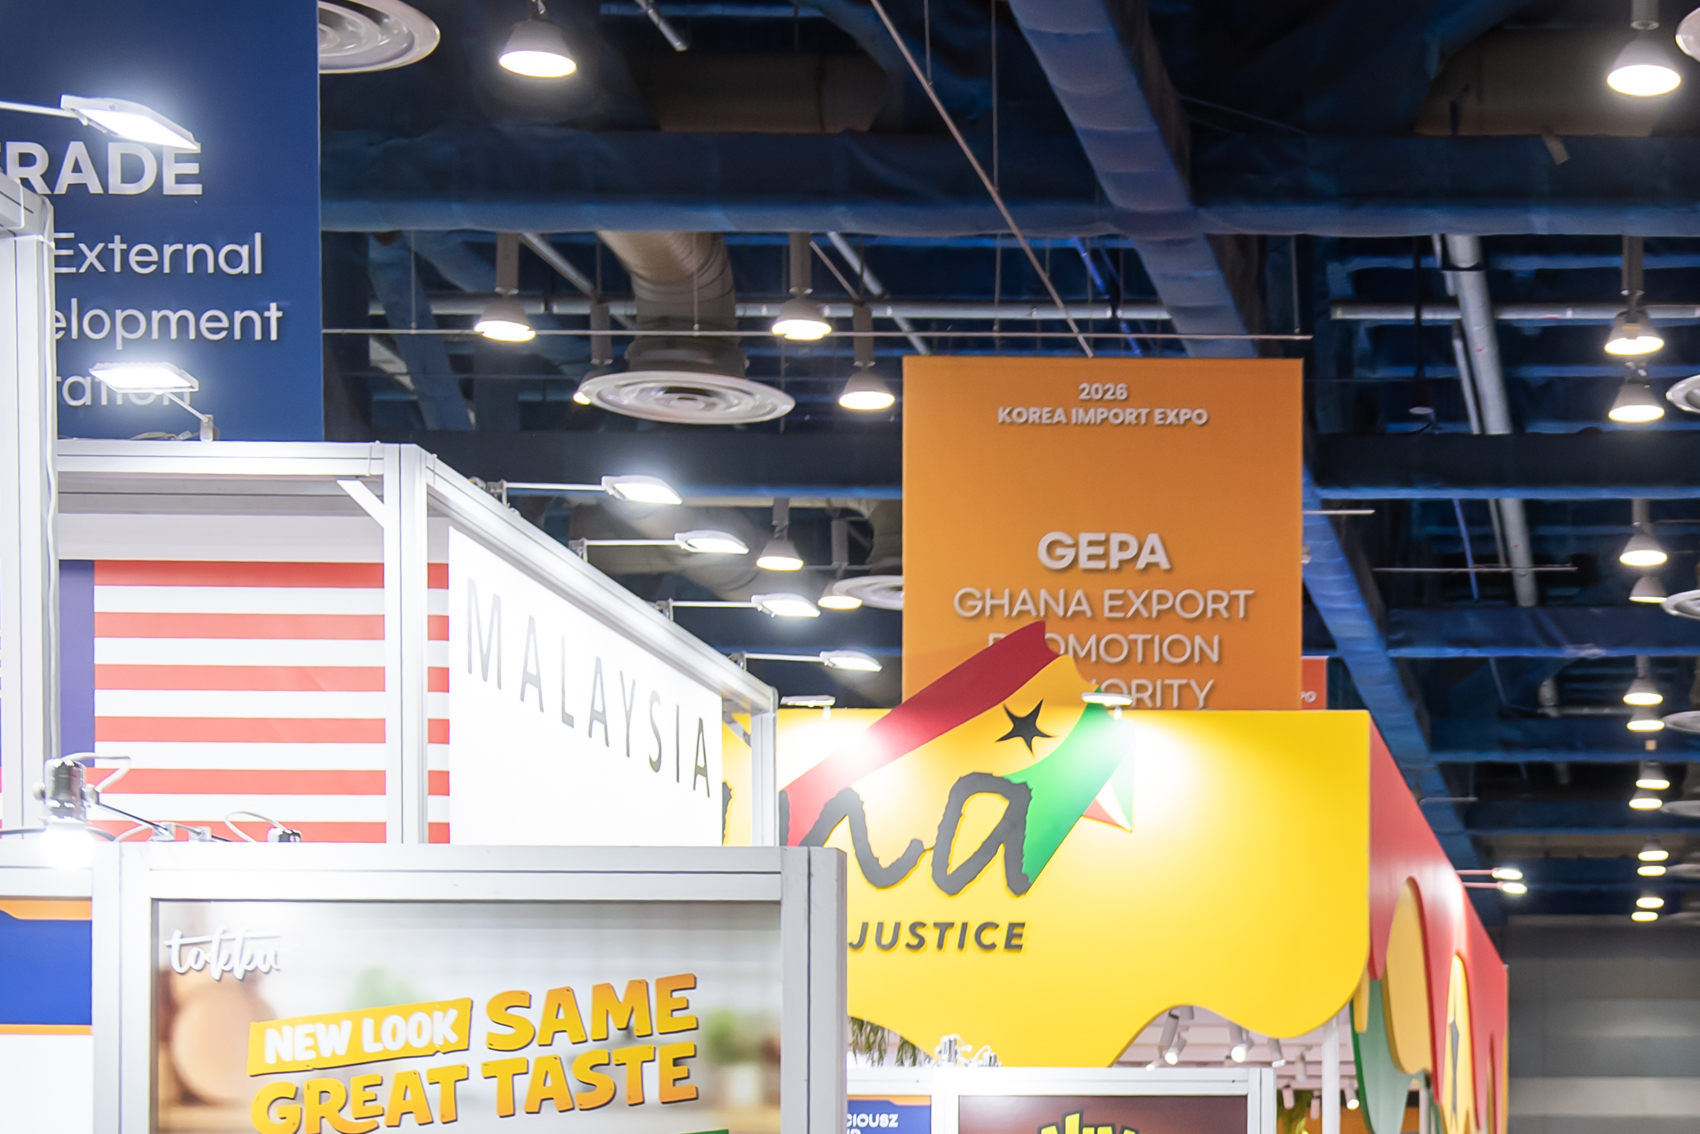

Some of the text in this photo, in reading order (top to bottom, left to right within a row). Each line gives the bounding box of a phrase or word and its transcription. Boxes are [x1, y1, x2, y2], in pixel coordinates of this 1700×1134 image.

[2, 141, 203, 195] RADE
[53, 232, 262, 274] External
[54, 298, 283, 350] elopment
[1078, 383, 1129, 401] 2026
[998, 407, 1208, 426] KOREA IMPORT EXPO
[1037, 531, 1171, 569] GEPA
[953, 587, 1255, 618] GHANA EXPORT
[988, 632, 1220, 663] OMOTION
[467, 576, 711, 798] MALAYSIA
[1098, 678, 1214, 708] ORITY
[849, 921, 1027, 952] JUSTICE
[264, 973, 698, 1065] NEW LOOK SAME
[482, 1043, 698, 1118] TASTE
